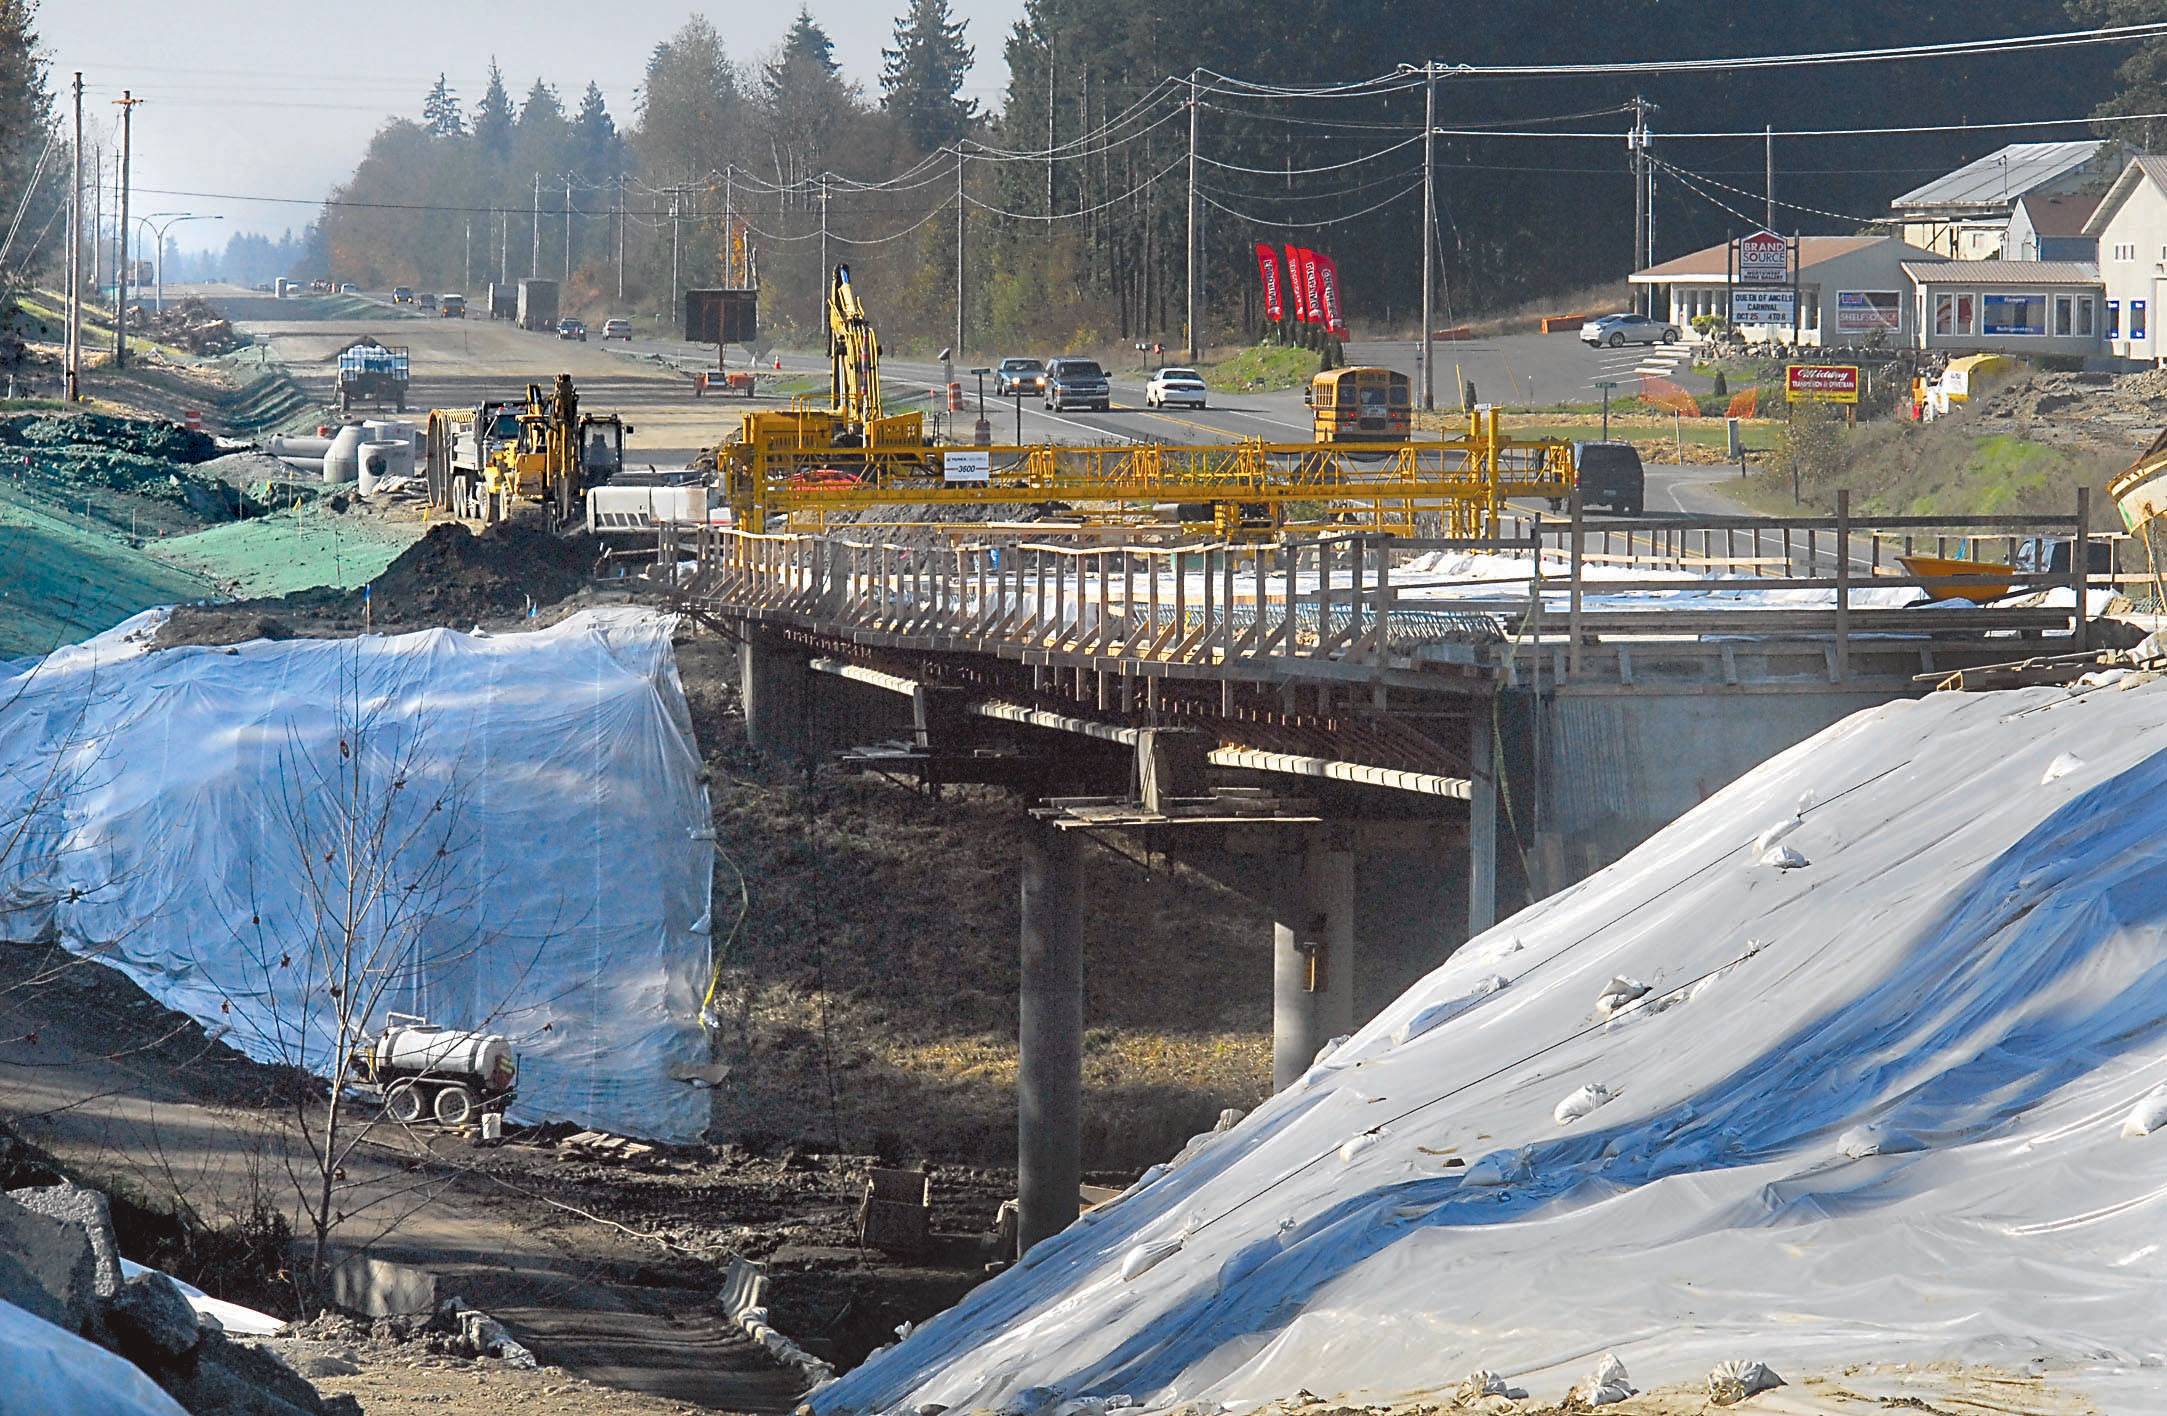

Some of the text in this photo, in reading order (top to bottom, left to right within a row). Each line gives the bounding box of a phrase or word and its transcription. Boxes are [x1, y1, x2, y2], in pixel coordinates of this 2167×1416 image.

[1744, 242, 1784, 251] BRAND
[1743, 252, 1785, 262] SOURCE
[1735, 294, 1757, 302] QUEEN
[1768, 294, 1793, 302] ANGELS
[1747, 303, 1777, 311] CARNIVAL
[1736, 312, 1749, 320] OCT
[1750, 312, 1759, 320] 25
[958, 465, 976, 473] 3600
